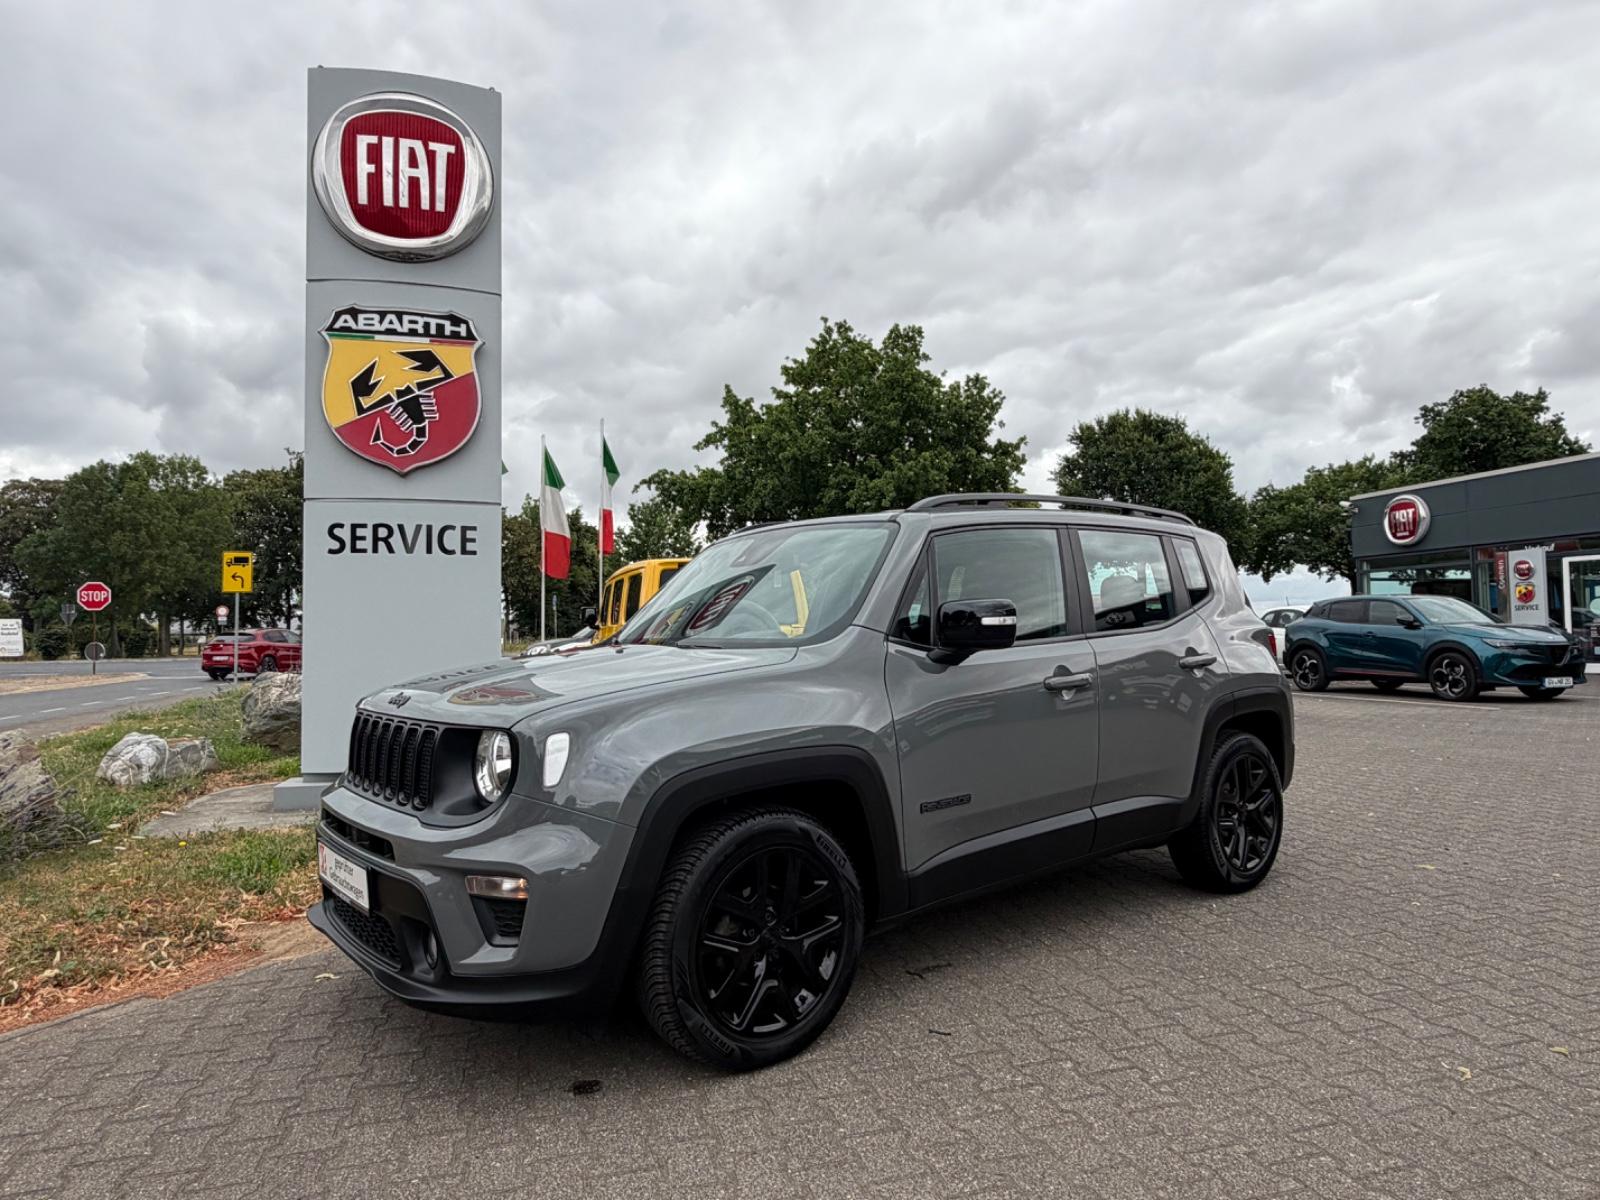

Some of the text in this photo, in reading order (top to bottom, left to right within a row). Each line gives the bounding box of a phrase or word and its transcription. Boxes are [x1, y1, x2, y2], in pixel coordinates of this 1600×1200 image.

[356, 133, 456, 213] FIAT
[333, 313, 467, 337] ABARTH
[1390, 508, 1415, 533] FIAT
[327, 522, 478, 556] SERVICE
[81, 590, 108, 602] STOP
